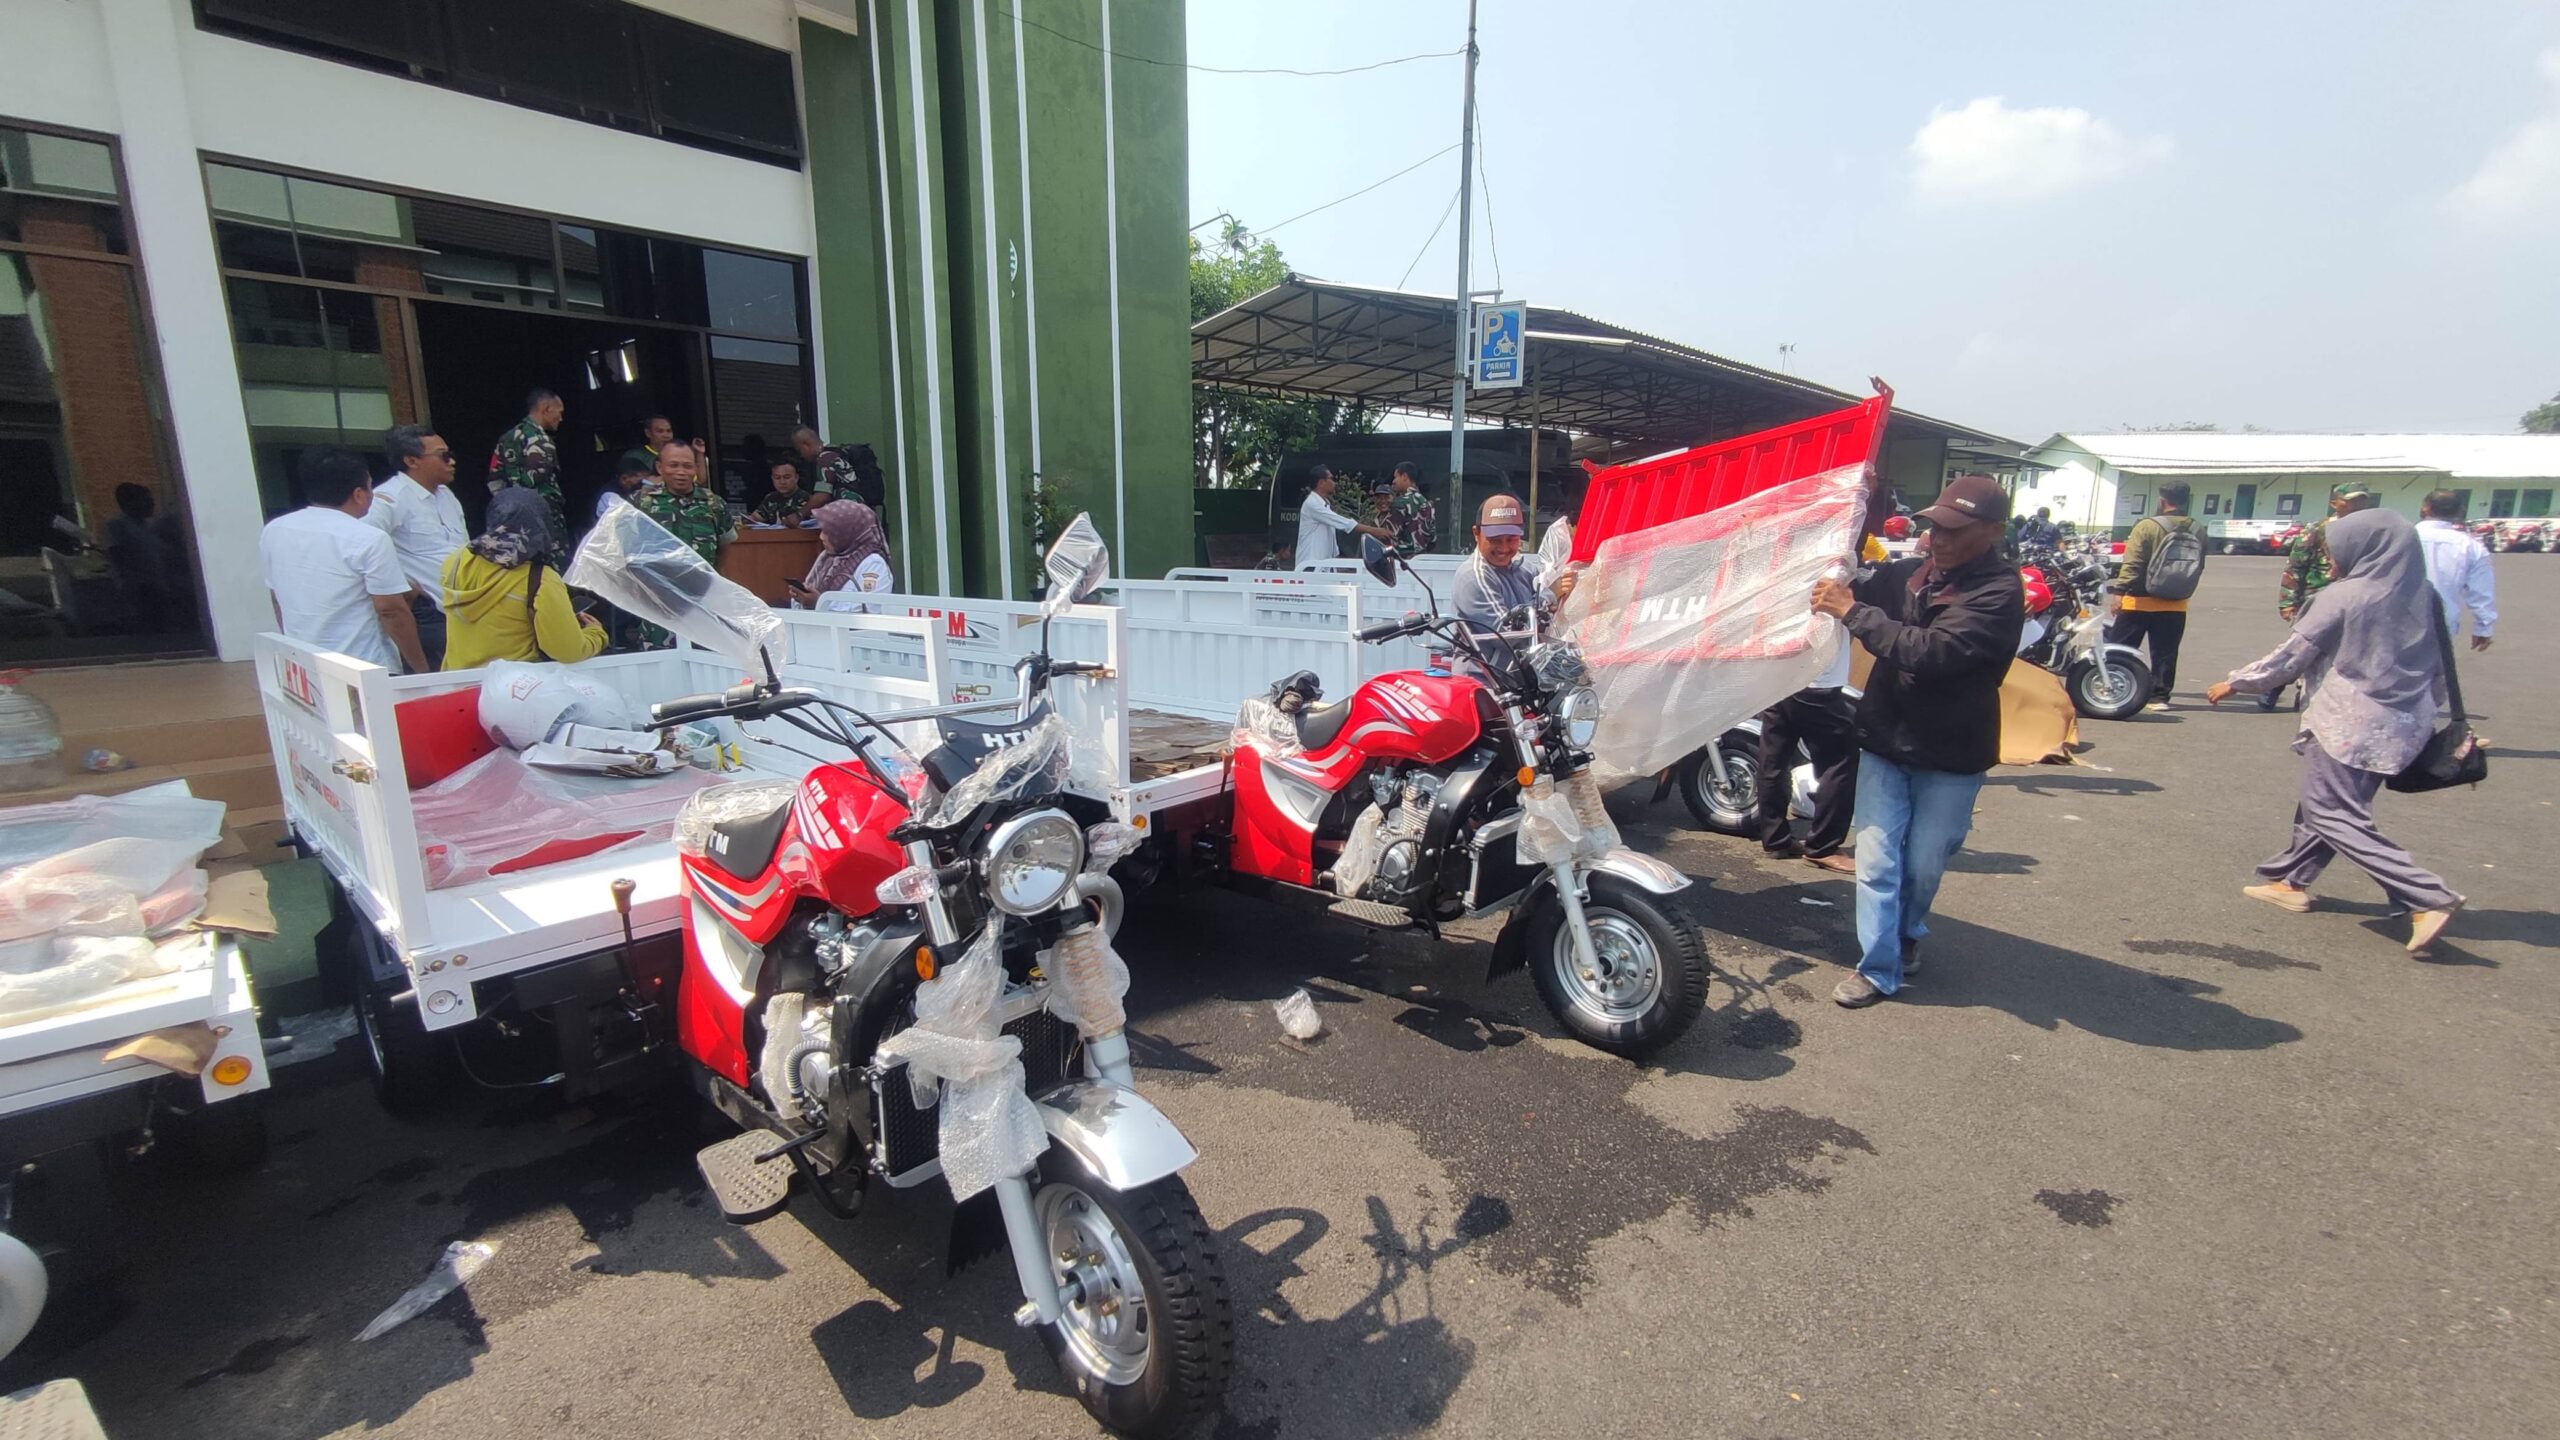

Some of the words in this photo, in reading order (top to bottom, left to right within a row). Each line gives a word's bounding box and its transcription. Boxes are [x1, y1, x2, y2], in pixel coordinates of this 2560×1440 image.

[1483, 311, 1503, 345] P
[1639, 594, 1708, 622] HTM
[808, 778, 828, 805] HTM
[708, 829, 730, 855] TM
